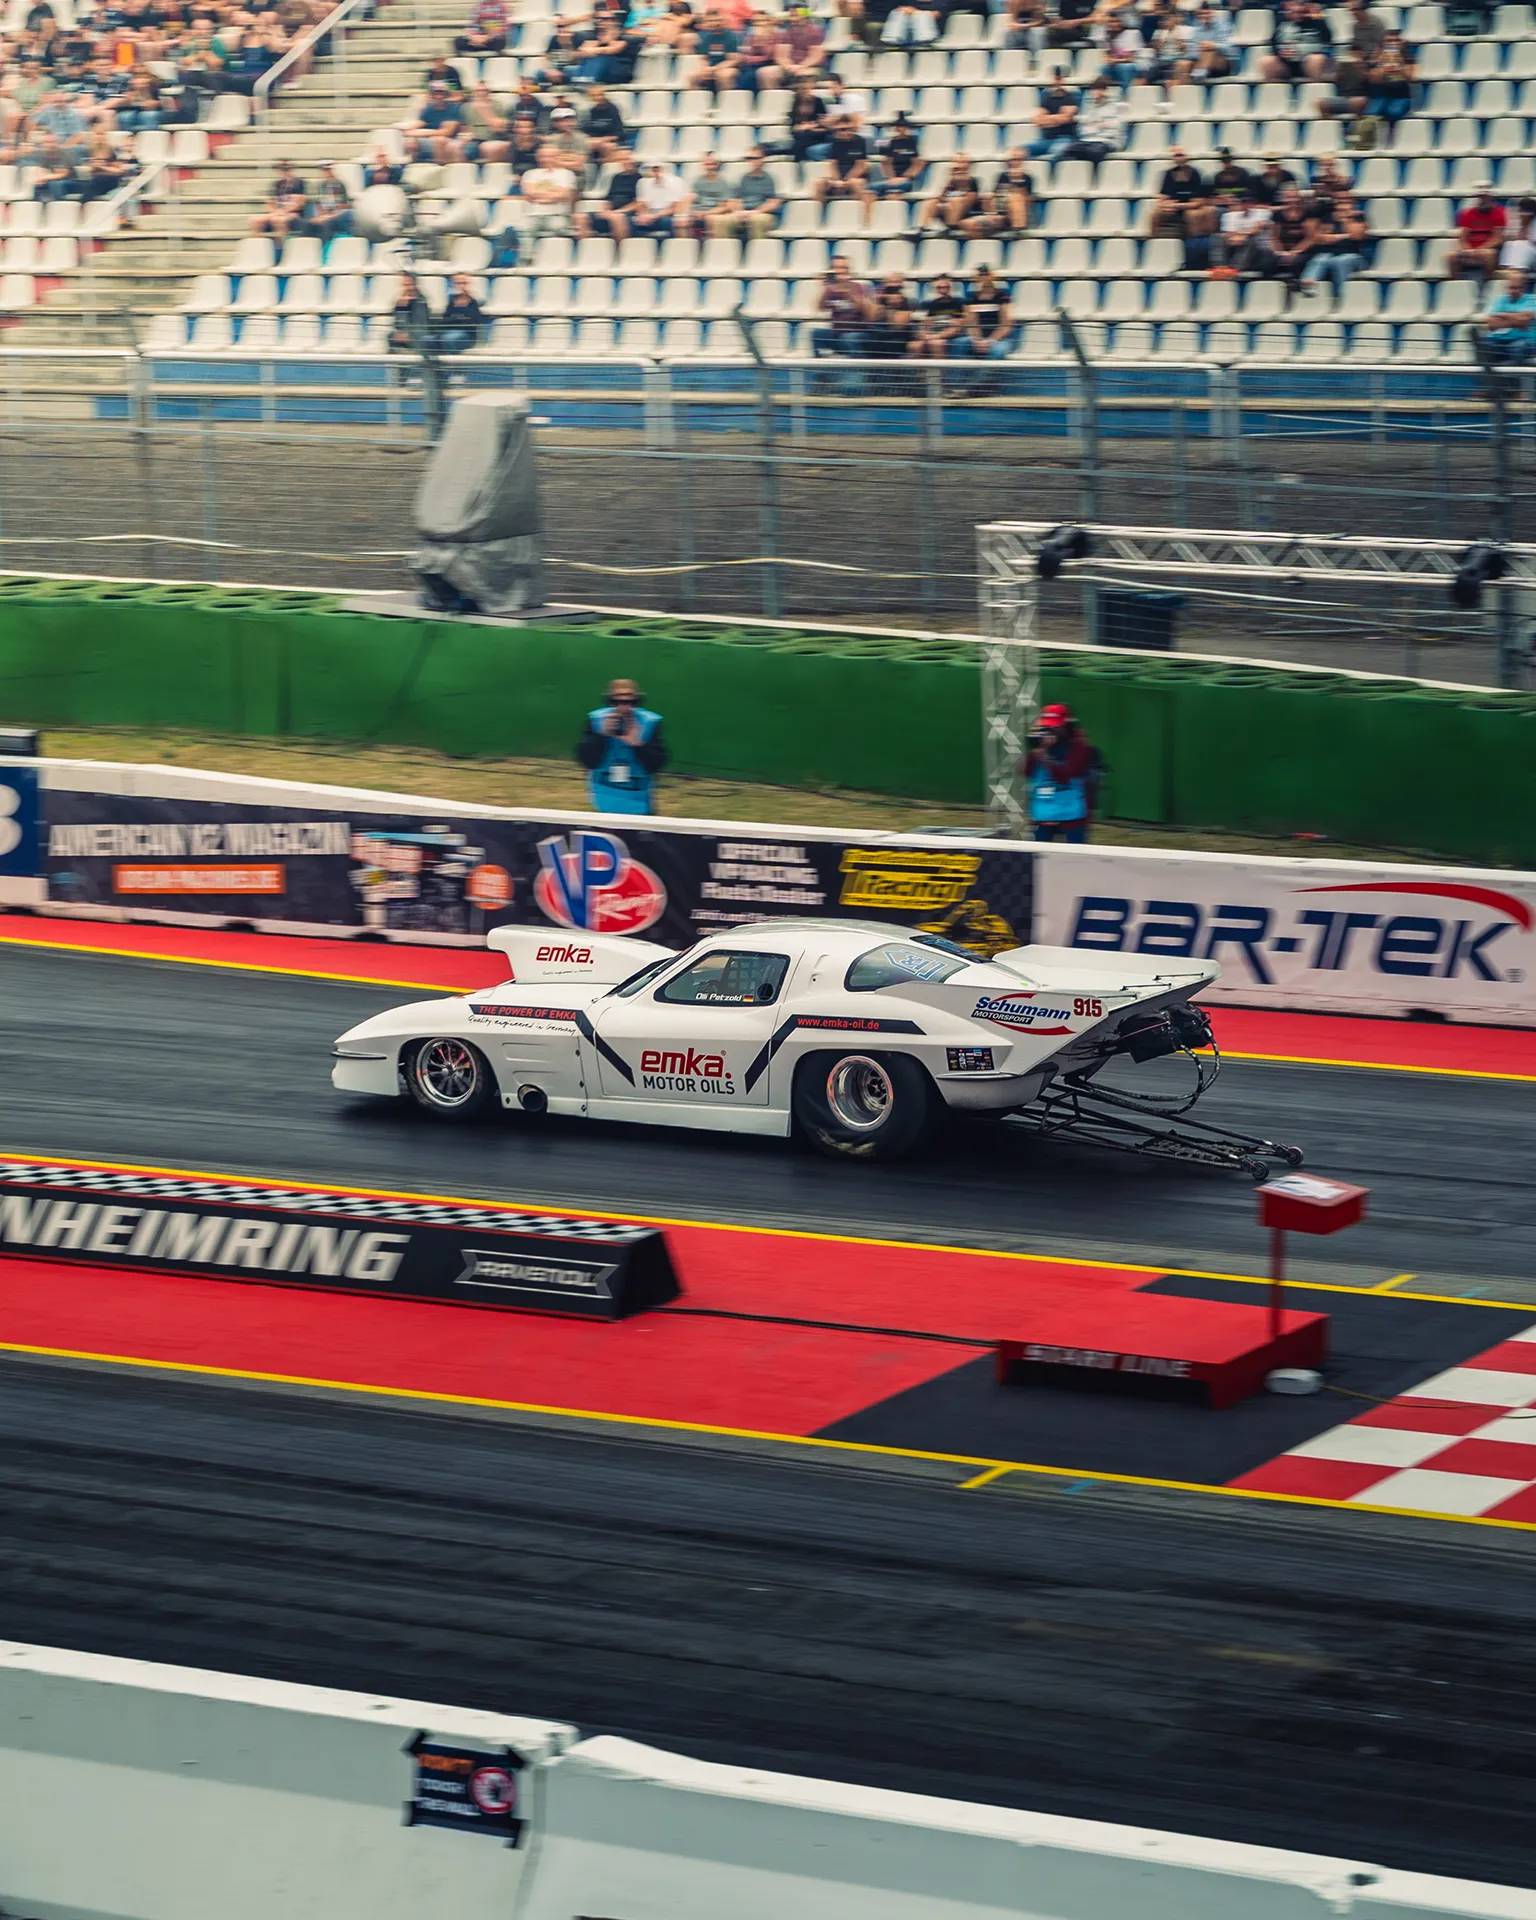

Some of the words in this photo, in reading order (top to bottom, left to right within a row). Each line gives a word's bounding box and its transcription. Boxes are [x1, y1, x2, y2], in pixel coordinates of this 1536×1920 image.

[709, 993, 742, 1001] Petzold
[479, 1005, 498, 1015] THE
[498, 1006, 532, 1017] POWER
[534, 1009, 548, 1018] OF
[549, 1010, 577, 1020] EMKA
[975, 997, 1071, 1020] Schumann
[1073, 998, 1102, 1017] 915
[797, 1018, 880, 1030] www.emka-oil.de
[973, 1010, 1032, 1024] MOTORSPORT
[642, 1075, 697, 1092] MOTOR
[700, 1079, 735, 1094] OILS
[1024, 1344, 1121, 1371] START
